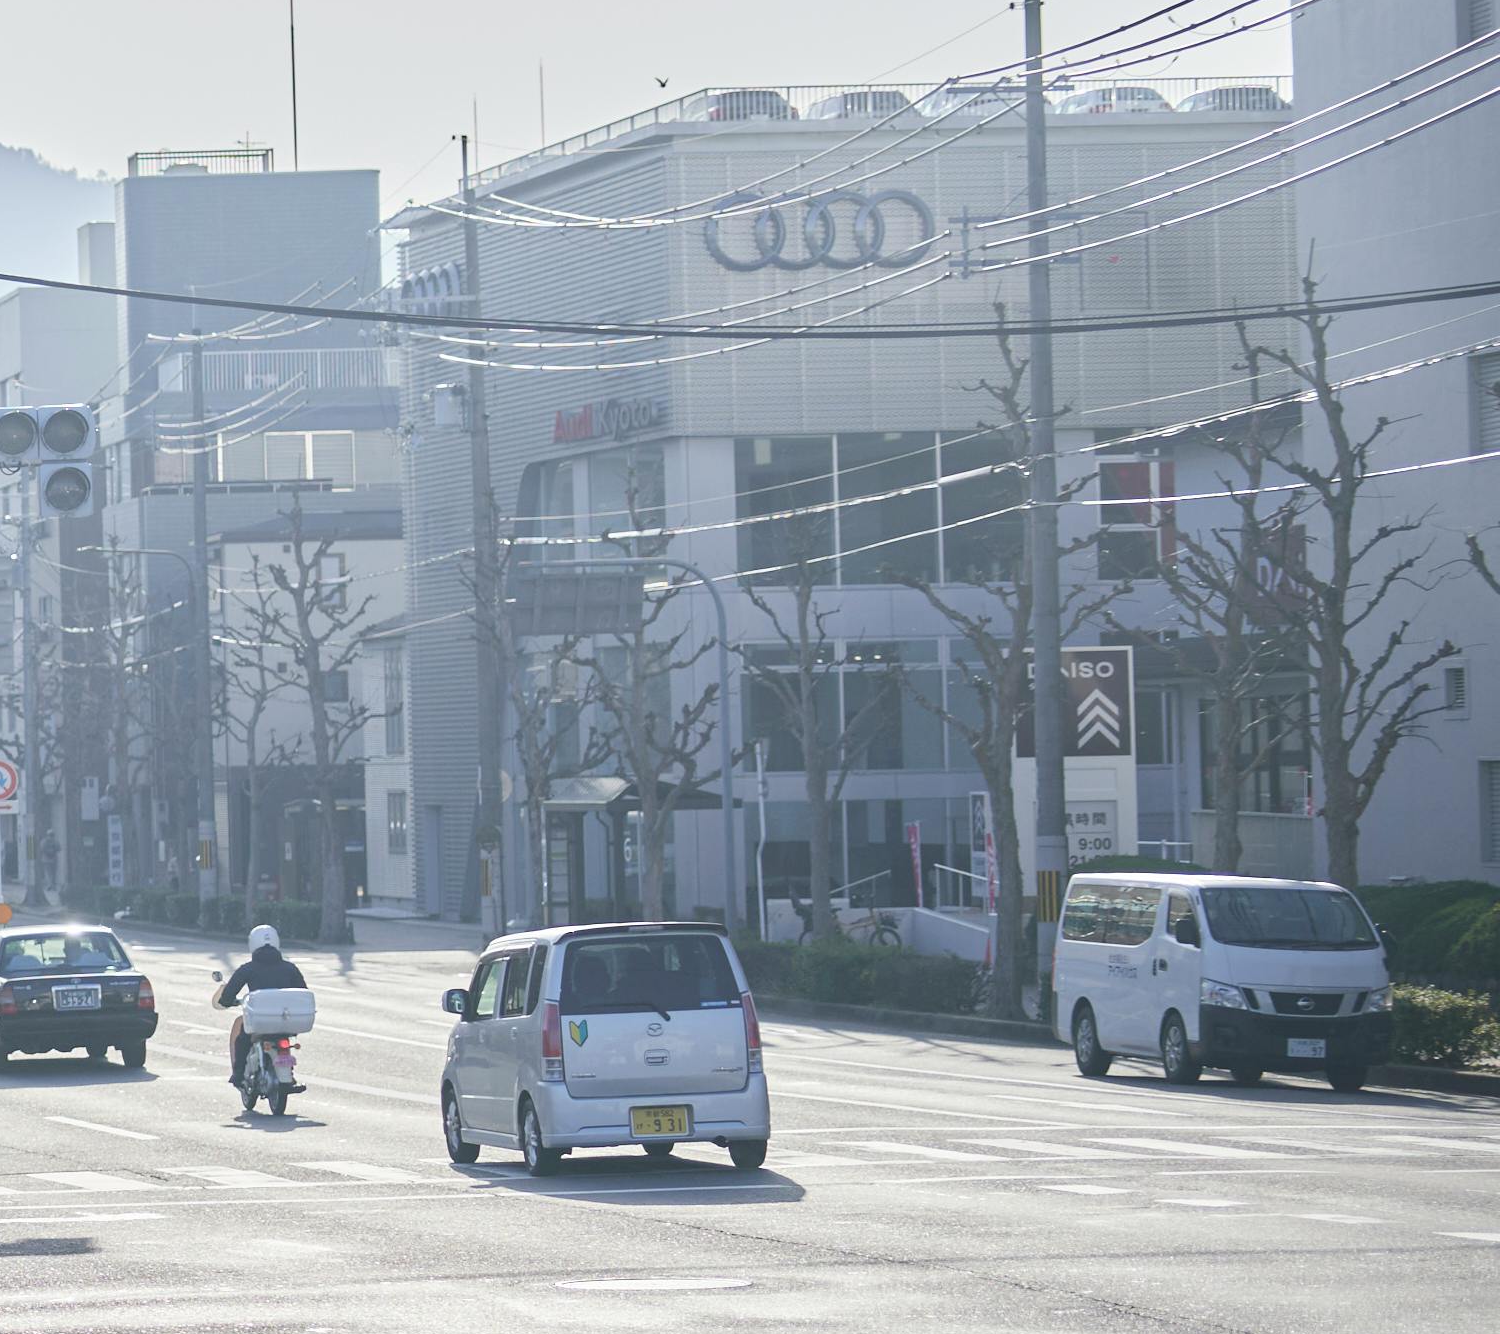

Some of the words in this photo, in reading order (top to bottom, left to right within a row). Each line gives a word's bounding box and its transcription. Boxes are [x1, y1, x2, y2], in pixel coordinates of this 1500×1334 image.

[554, 404, 592, 443] Audi
[600, 398, 649, 442] Kyoto
[1027, 660, 1115, 678] ISO
[1078, 837, 1112, 851] 9:00
